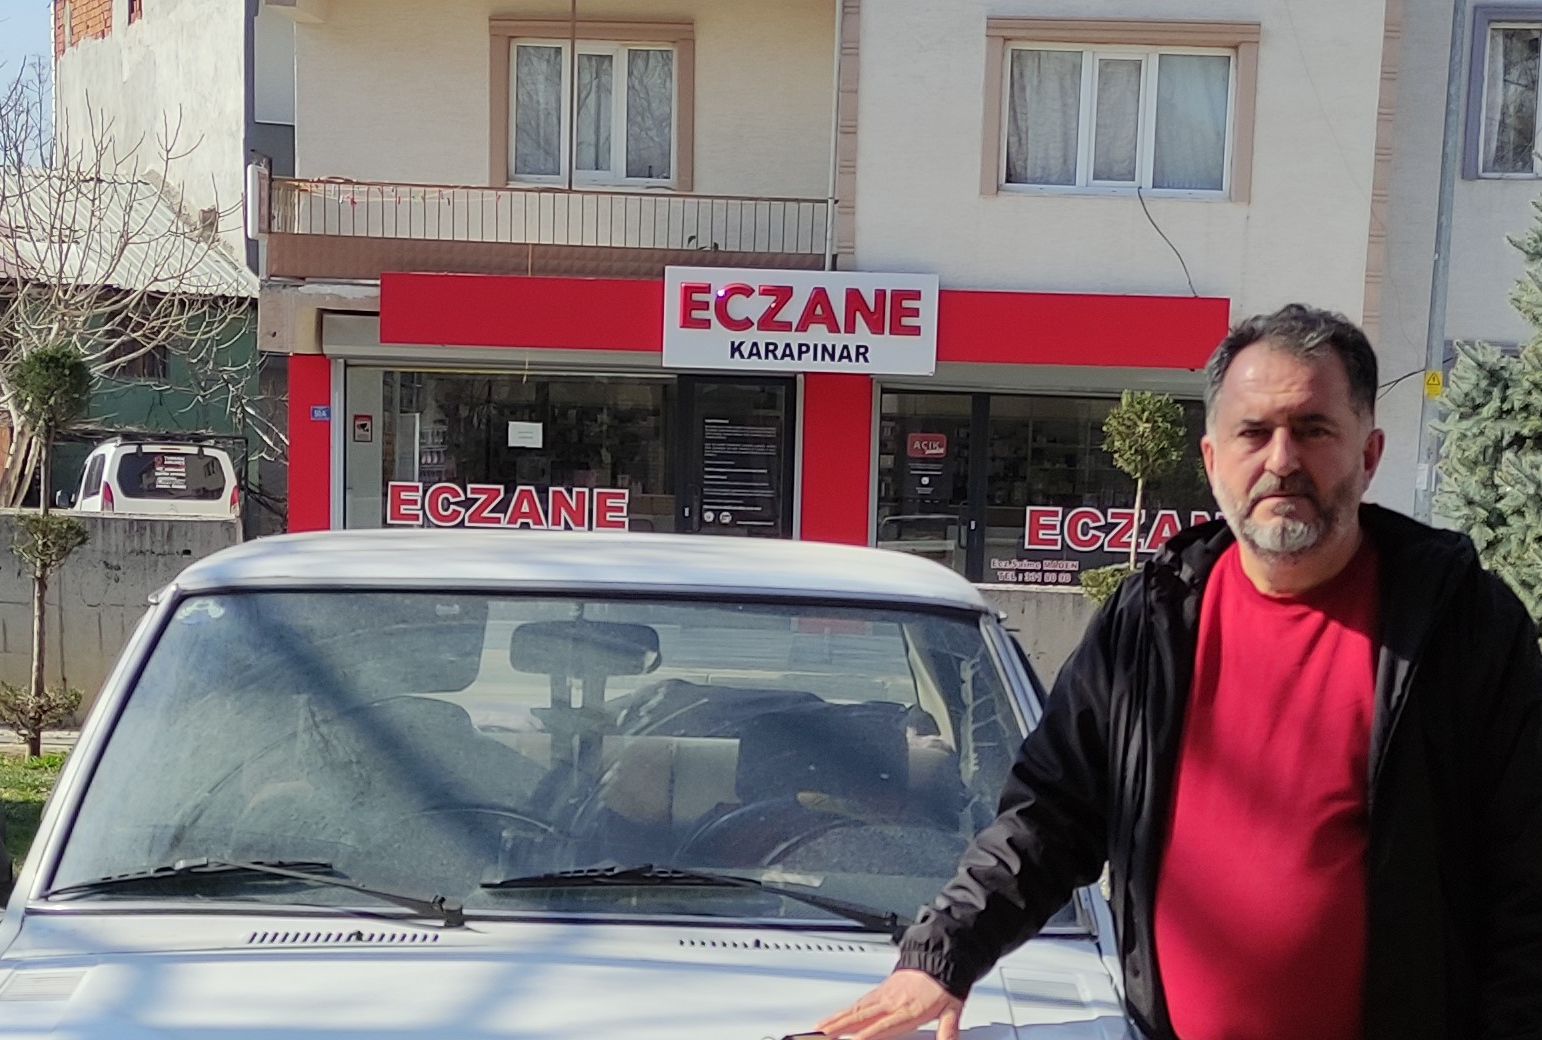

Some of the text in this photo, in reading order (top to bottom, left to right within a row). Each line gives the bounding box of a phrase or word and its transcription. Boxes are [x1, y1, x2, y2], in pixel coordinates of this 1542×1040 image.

[678, 281, 922, 337] ECZANE
[729, 340, 871, 364] KARAPINAR
[386, 481, 629, 531] ECZANE
[1024, 506, 1226, 553] ECZA
